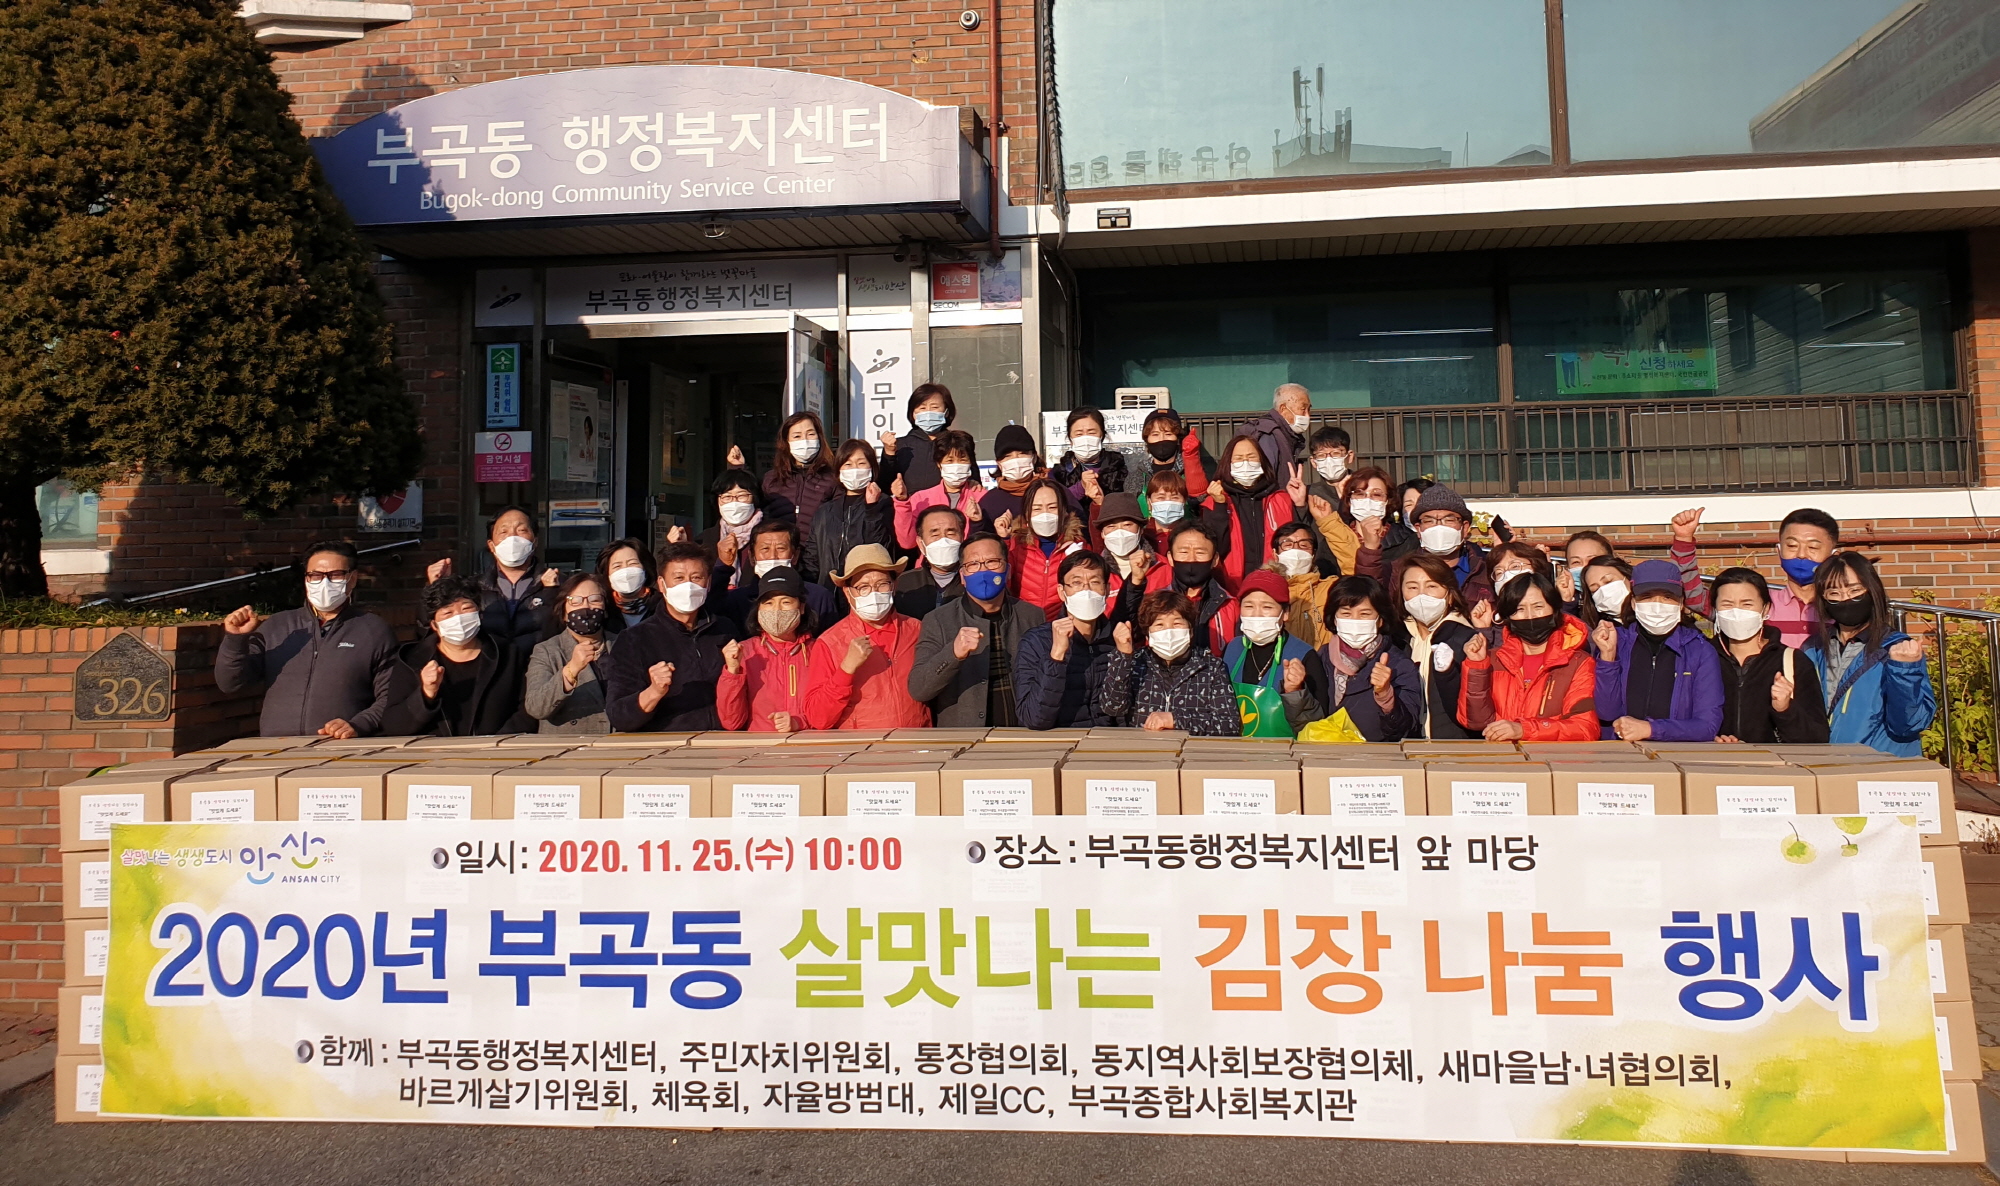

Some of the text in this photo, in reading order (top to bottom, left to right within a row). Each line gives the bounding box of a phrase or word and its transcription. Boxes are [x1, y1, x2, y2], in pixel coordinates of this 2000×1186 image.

[367, 102, 888, 183] 부곡동 행정복지센터
[420, 175, 836, 211] Bugok-dong Community Service Center
[940, 274, 971, 287] 에스원
[585, 283, 793, 313] 부곡동행정복지센터
[933, 301, 959, 309] SECOM
[486, 454, 522, 464] 금연시설
[94, 678, 166, 715] 326
[121, 847, 232, 866] 살맛나는 생생도시
[805, 838, 901, 870] 10:00
[1086, 834, 1398, 870] 부곡동행정복지센터
[1417, 836, 1451, 870] 앞
[1468, 835, 1538, 871] 마당
[281, 875, 341, 883] ANSAN CITY
[154, 908, 1878, 1020] 2020년 부곡동 살맛나는 김장 나눔 행사
[398, 1040, 665, 1074] 부곡동행정복지센터,
[680, 1042, 899, 1075] 주민자치위원회,
[915, 1043, 1077, 1078] 통장협의회,
[1092, 1045, 1422, 1084] 동지역사회보장협의체,
[400, 1077, 1357, 1121] 바르게살기위원회, 체육회, 자율방범대, 제일CC, 부곡종합사회복지관
